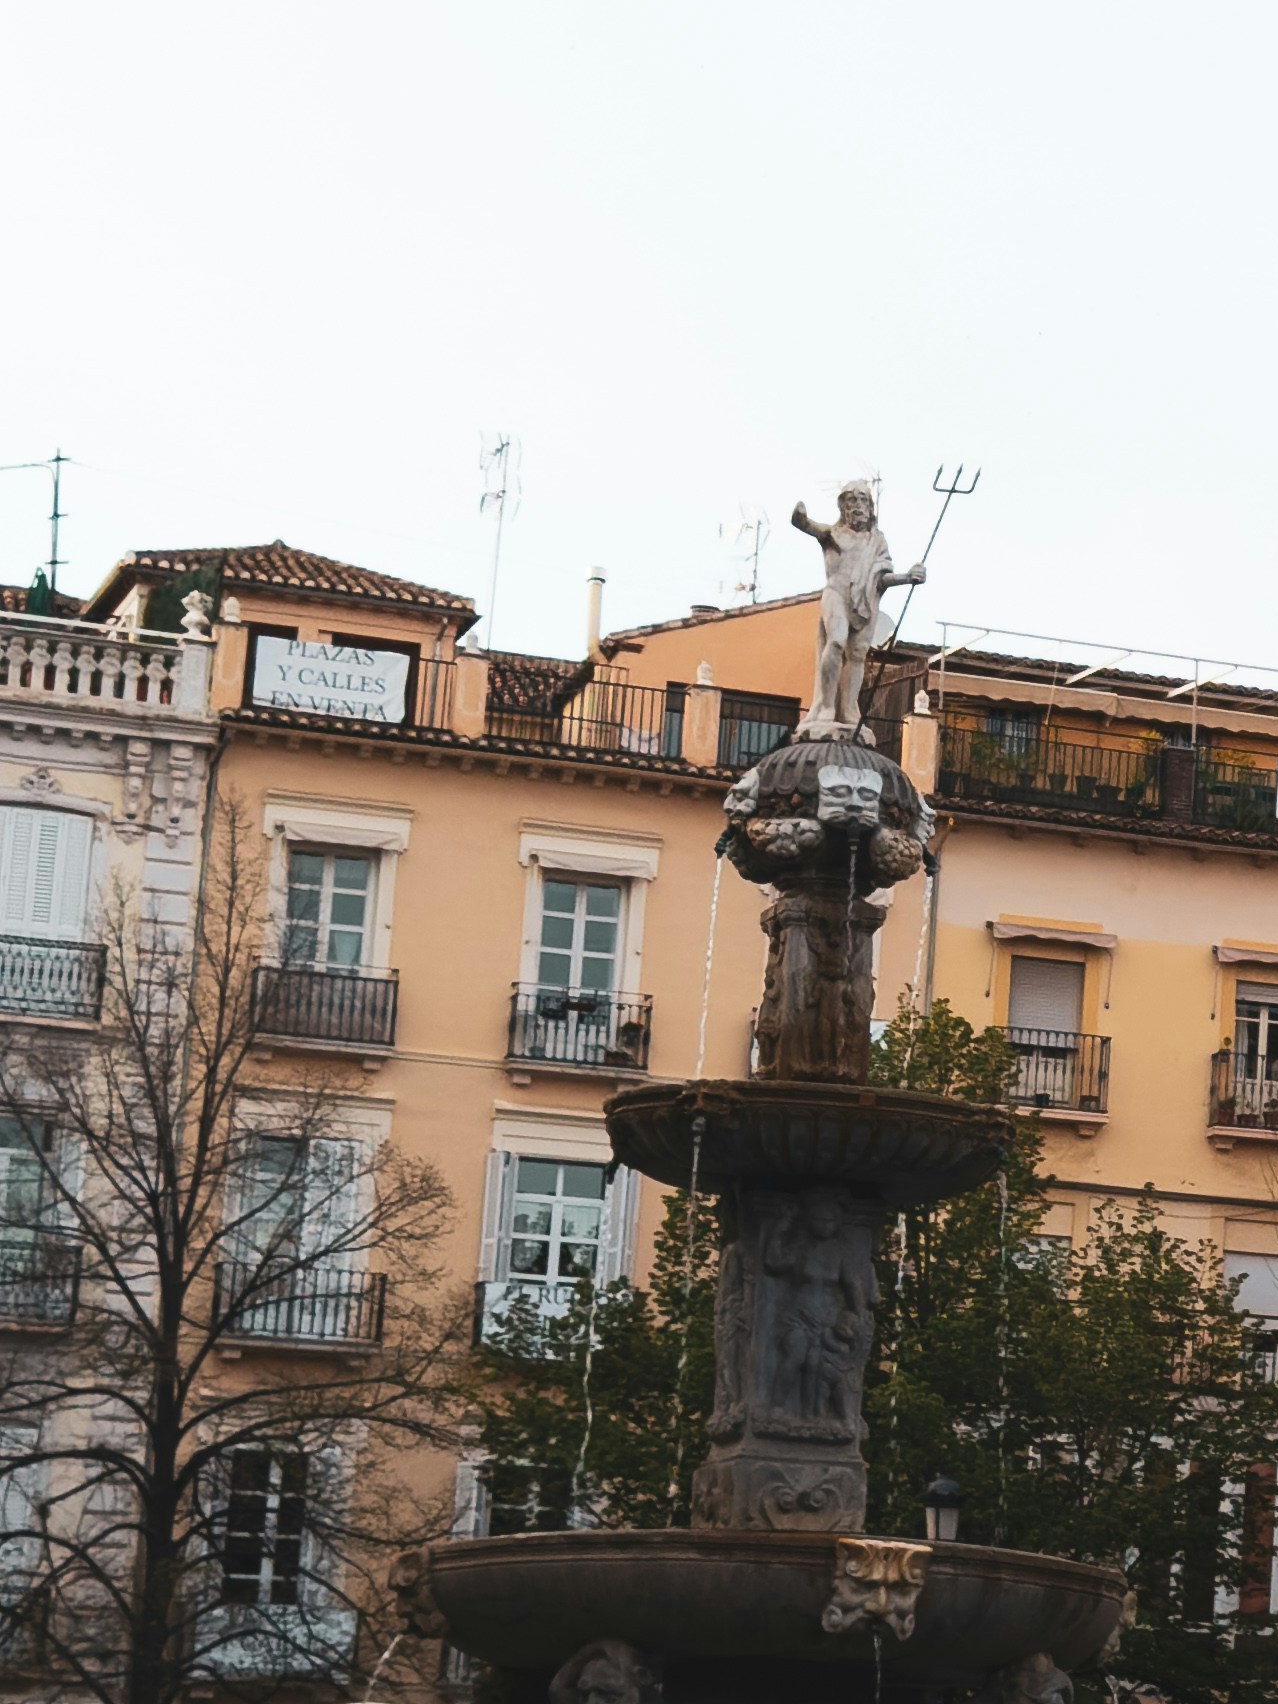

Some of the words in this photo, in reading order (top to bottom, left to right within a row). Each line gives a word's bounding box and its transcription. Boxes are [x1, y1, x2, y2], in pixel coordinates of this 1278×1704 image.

[288, 640, 375, 666] PLAZAS
[277, 664, 292, 681] Y
[298, 668, 387, 695] CALLES
[270, 690, 304, 708] EN
[308, 696, 388, 721] VENTA
